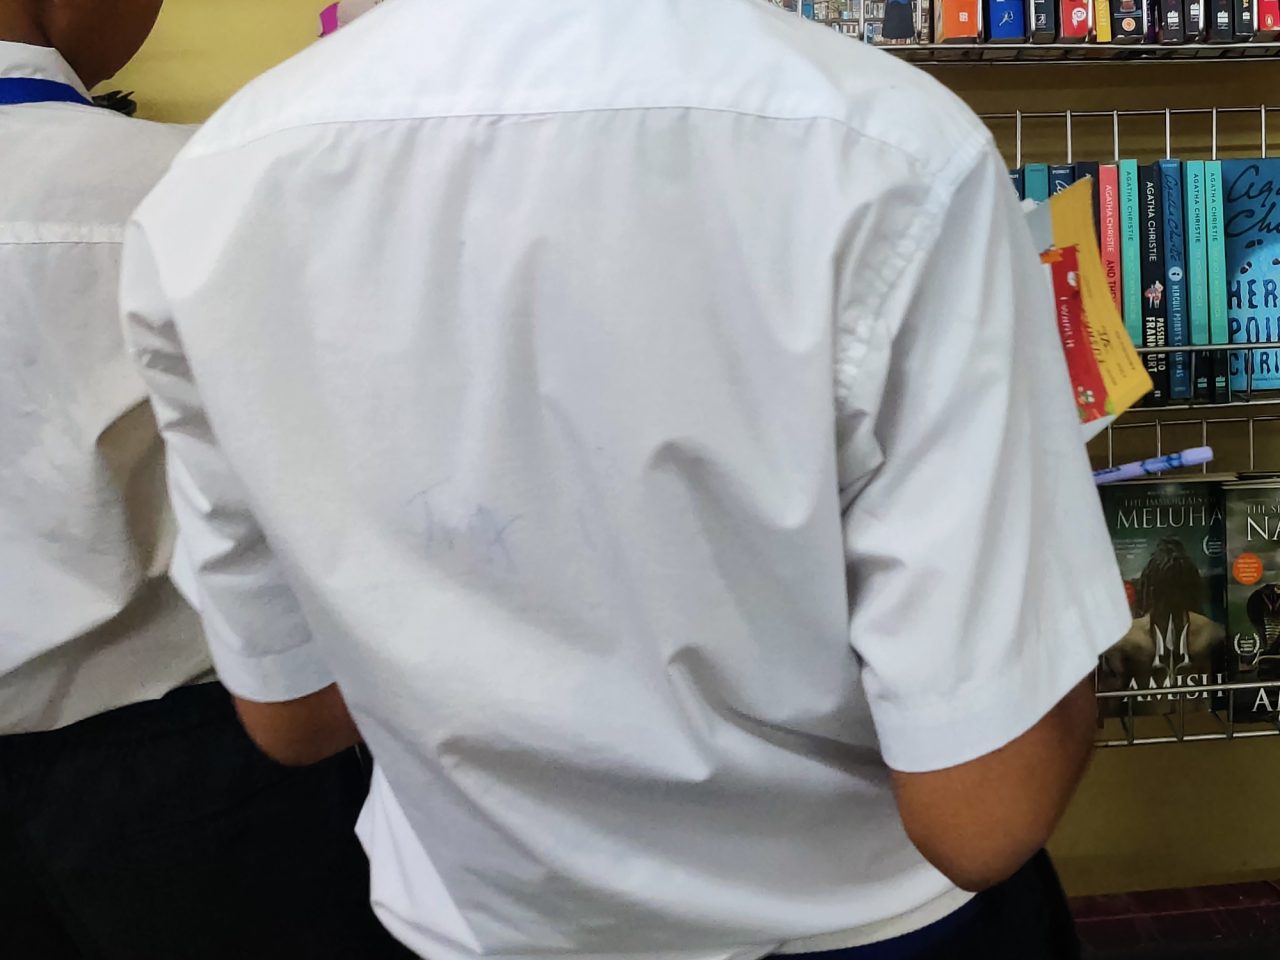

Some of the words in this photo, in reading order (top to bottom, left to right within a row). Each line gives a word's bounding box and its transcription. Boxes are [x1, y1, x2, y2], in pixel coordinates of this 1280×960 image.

[1106, 184, 1114, 216] AGATHA
[1126, 170, 1134, 204] AGATHA
[1146, 181, 1156, 217] AGATHA
[1107, 216, 1115, 252] CHRISTIE
[1148, 220, 1158, 262] CHRISTIE
[1107, 259, 1116, 278] AND
[1117, 508, 1224, 529] MELUHA
[1247, 504, 1266, 514] THE
